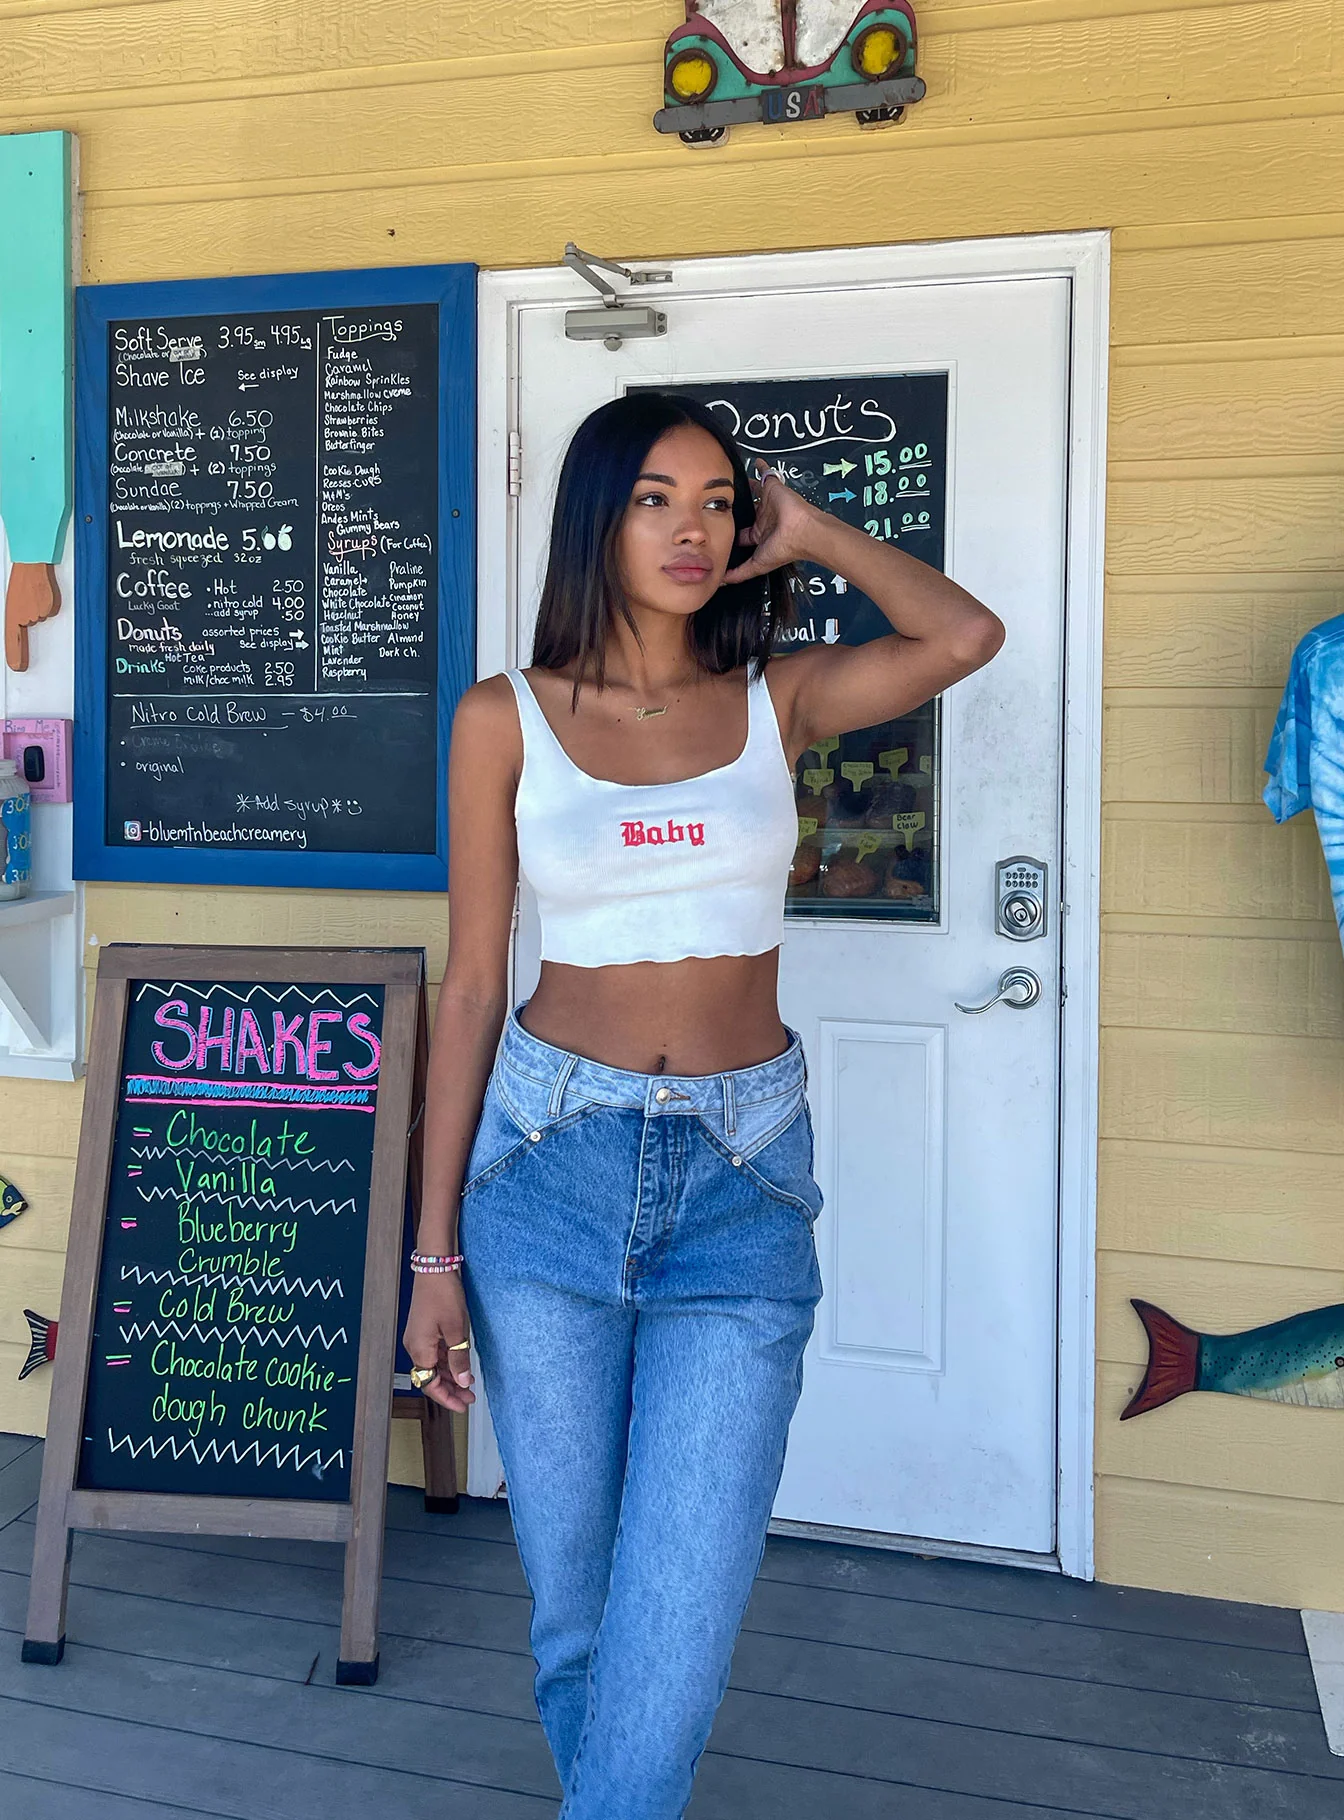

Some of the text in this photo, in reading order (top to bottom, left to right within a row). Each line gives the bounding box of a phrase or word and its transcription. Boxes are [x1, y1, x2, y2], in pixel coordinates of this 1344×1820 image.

[769, 90, 820, 120] USA
[323, 316, 403, 342] Toppings
[115, 326, 152, 351] Soft
[156, 326, 204, 350] Serve
[217, 326, 254, 348] 3.95
[271, 325, 301, 345] 4.95
[161, 350, 170, 358] or
[327, 346, 358, 362] Fudge
[116, 362, 205, 387] Shave Ice
[260, 365, 298, 381] display
[325, 359, 373, 376] Caramel
[325, 376, 361, 388] Rainbow
[324, 389, 381, 400] Marshmallow
[115, 404, 273, 428] Milkshake 6.50
[325, 401, 393, 415] Chocolate Chips
[324, 414, 378, 425] Strawberries
[704, 394, 897, 442] Donuts
[226, 427, 265, 443] topping
[324, 427, 384, 438] Brownie Bites
[115, 442, 271, 462] Concrete 7.50
[325, 439, 375, 453] Butterfinger
[864, 443, 932, 476] 15.00
[228, 462, 276, 478] toppings
[355, 463, 380, 478] Dough
[115, 477, 273, 499] Sundae 7.50
[863, 474, 930, 507] 18.00
[186, 500, 221, 515] toppings
[229, 500, 265, 511] Whipped
[268, 497, 299, 508] Cream
[322, 502, 345, 511] Oreos
[321, 508, 378, 524] Andes Mints
[116, 521, 229, 551] Lemonade
[337, 520, 400, 536] Gummy Bears
[328, 531, 377, 562] Syrups
[380, 535, 402, 554] (For
[130, 552, 164, 565] fresh
[170, 552, 223, 569] squeezed
[323, 560, 423, 577] Vanilla Praline
[116, 569, 192, 598] Coffee
[214, 579, 304, 595] Hot 2.50
[324, 573, 361, 586] Caramel
[323, 585, 367, 598] Chocolate
[128, 600, 180, 615] Lucky Goat
[213, 595, 305, 610] nitro cold 4.00
[322, 595, 424, 611] White Chocolate Coconut
[233, 609, 259, 620] syrup
[324, 610, 419, 621] Hazelnut Honey
[117, 617, 182, 640] Donuts
[202, 624, 279, 641] assorted prices
[320, 620, 409, 632] Toasted Marshmallow
[260, 638, 294, 651] display
[352, 632, 380, 644] Butter
[388, 631, 423, 643] Almond
[129, 641, 215, 656] made fresh daily
[323, 645, 343, 655] Mint
[165, 653, 205, 662] Hot Tea
[322, 655, 363, 666] Lavender
[210, 660, 251, 675] products
[265, 662, 295, 674] 2.50
[322, 667, 366, 681] Raspberry
[265, 674, 294, 686] 2.95
[131, 702, 177, 724] Nitro
[186, 701, 221, 724] Cold
[226, 701, 267, 724] Brew
[136, 756, 184, 781] original
[620, 819, 705, 847] Baby
[151, 1000, 382, 1080] SHAKES
[166, 1109, 316, 1158] Chocolate
[176, 1158, 277, 1197] Vanilla
[178, 1201, 298, 1252] Blueberry
[178, 1248, 285, 1277] Crumble
[159, 1285, 294, 1323] Cold Brew
[150, 1339, 258, 1382] Chocolate
[152, 1383, 226, 1437] dough
